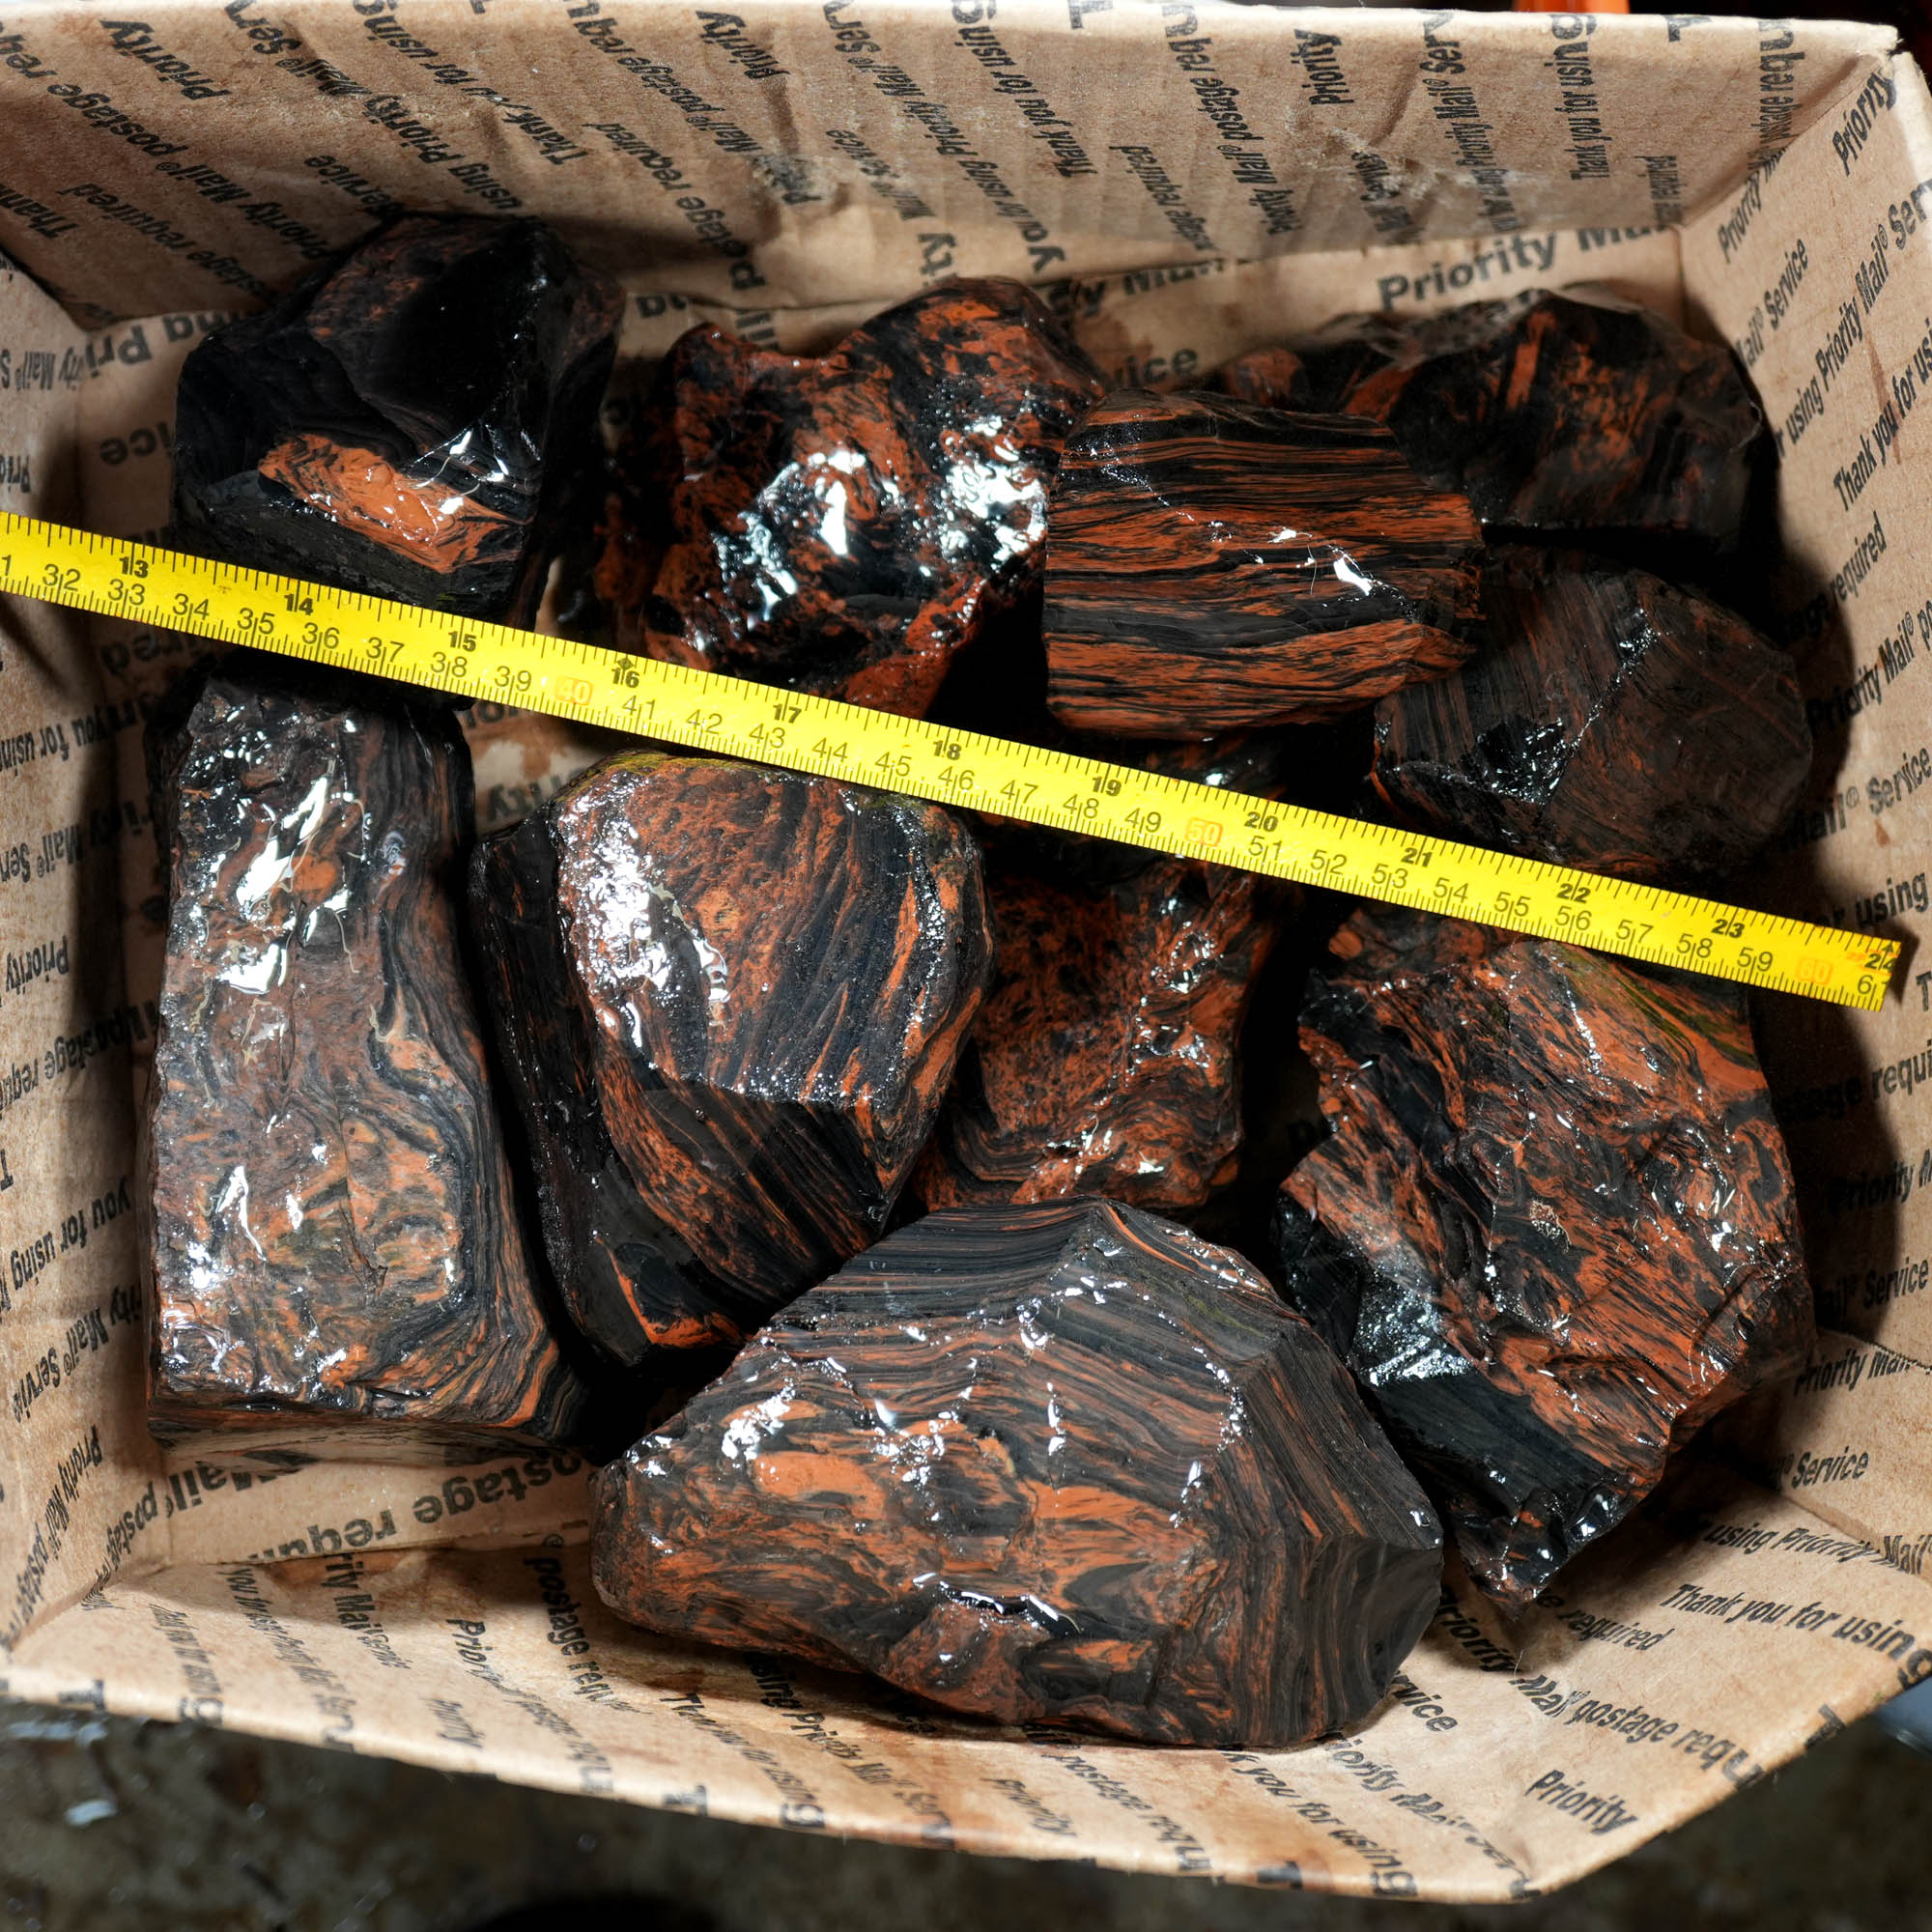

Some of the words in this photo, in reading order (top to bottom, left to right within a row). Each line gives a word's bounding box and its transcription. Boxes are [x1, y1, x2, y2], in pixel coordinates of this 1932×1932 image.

[99, 17, 232, 100] Priority
[694, 10, 791, 81] Priority
[1294, 29, 1354, 106] Priority
[274, 56, 375, 98] Mail®
[419, 62, 479, 85] for
[617, 54, 726, 116] postage
[847, 56, 927, 99] Mail®
[989, 70, 1039, 95] for
[1422, 77, 1482, 120] Mail®
[46, 83, 188, 157] postage
[361, 95, 466, 164] Priority
[902, 100, 980, 157] Priority
[1013, 98, 1074, 128] you
[1189, 76, 1264, 142] postage
[1553, 95, 1600, 114] for
[1565, 117, 1613, 142] you
[501, 112, 587, 166] Thank
[583, 122, 694, 191] required
[684, 115, 763, 155] Mail®
[1032, 129, 1098, 178] Thank
[1445, 121, 1497, 168] Priority
[155, 159, 251, 205] Mail®
[448, 162, 524, 211] using
[958, 158, 1014, 199] using
[1109, 144, 1186, 209] required
[1216, 144, 1281, 185] Mail®
[1563, 145, 1611, 182] Thank
[1634, 155, 1689, 201] required
[60, 184, 196, 251] required
[676, 196, 767, 292] postage
[1718, 170, 1761, 263] Priority
[1012, 220, 1066, 273] you
[1378, 232, 1556, 312] Priority
[1764, 239, 1809, 331] Service
[1785, 384, 1825, 445] using
[1815, 296, 1863, 392] Priority
[1855, 223, 1889, 316] Mail®
[1833, 434, 1879, 512] Thank
[1871, 410, 1900, 466] you
[1891, 365, 1918, 425] for
[1829, 510, 1888, 602] required
[1806, 661, 1884, 726] Priority
[1877, 611, 1915, 685] Mail®
[39, 724, 70, 761] for
[43, 563, 81, 592] 32
[107, 579, 146, 606] 33
[172, 593, 211, 621] 34
[237, 608, 275, 636] 35
[301, 622, 340, 649] 36
[366, 637, 405, 663] 37
[431, 651, 468, 678] 38
[495, 666, 532, 693] 39
[557, 679, 591, 704] 40
[622, 695, 656, 720] 41
[687, 709, 723, 735] 42
[750, 724, 786, 749] 43
[812, 737, 848, 763] 44
[875, 752, 912, 777] 45
[938, 765, 976, 791] 46
[1001, 780, 1038, 804] 47
[1063, 794, 1099, 819] 48
[1124, 808, 1162, 834] 49
[1187, 821, 1221, 846] 50
[1247, 835, 1283, 862] 51
[1310, 849, 1348, 876] 52
[1371, 863, 1408, 889] 53
[1433, 877, 1469, 903] 54
[1493, 892, 1531, 917] 55
[1554, 905, 1593, 931] 56
[1615, 919, 1654, 945] 57
[1676, 933, 1714, 958] 58
[1737, 947, 1774, 973] 59
[119, 555, 149, 580] 13
[284, 594, 315, 615] 14
[448, 631, 477, 652] 15
[611, 667, 639, 688] 16
[773, 703, 802, 724] 17
[933, 740, 962, 761] 18
[1092, 776, 1122, 797] 19
[1244, 811, 1279, 833] 20
[1401, 847, 1433, 867] 21
[1556, 883, 1591, 904] 22
[1712, 919, 1746, 939] 23
[1864, 952, 1896, 974] 24
[1866, 748, 1932, 815] Service
[37, 823, 86, 878] Mail®
[1856, 872, 1929, 928] using
[6, 934, 70, 995] Priority
[91, 1175, 131, 1230] you
[61, 1209, 88, 1253] for
[10, 1231, 56, 1291] using
[1863, 1257, 1930, 1310] Service
[63, 1306, 110, 1377] Mail®
[1793, 1350, 1867, 1398] Priority
[1791, 1446, 1870, 1490] Service
[1706, 1523, 1778, 1554] using
[1776, 1526, 1880, 1564] Priority
[523, 1554, 591, 1657] postage
[1556, 1608, 1676, 1652] required
[1659, 1583, 1742, 1624] Thank
[1726, 1595, 1791, 1626] you
[1784, 1600, 1841, 1632] for
[1569, 1693, 1679, 1742] postage
[1233, 1767, 1304, 1798] you
[1288, 1802, 1341, 1827] for
[1524, 1769, 1638, 1833] Priority
